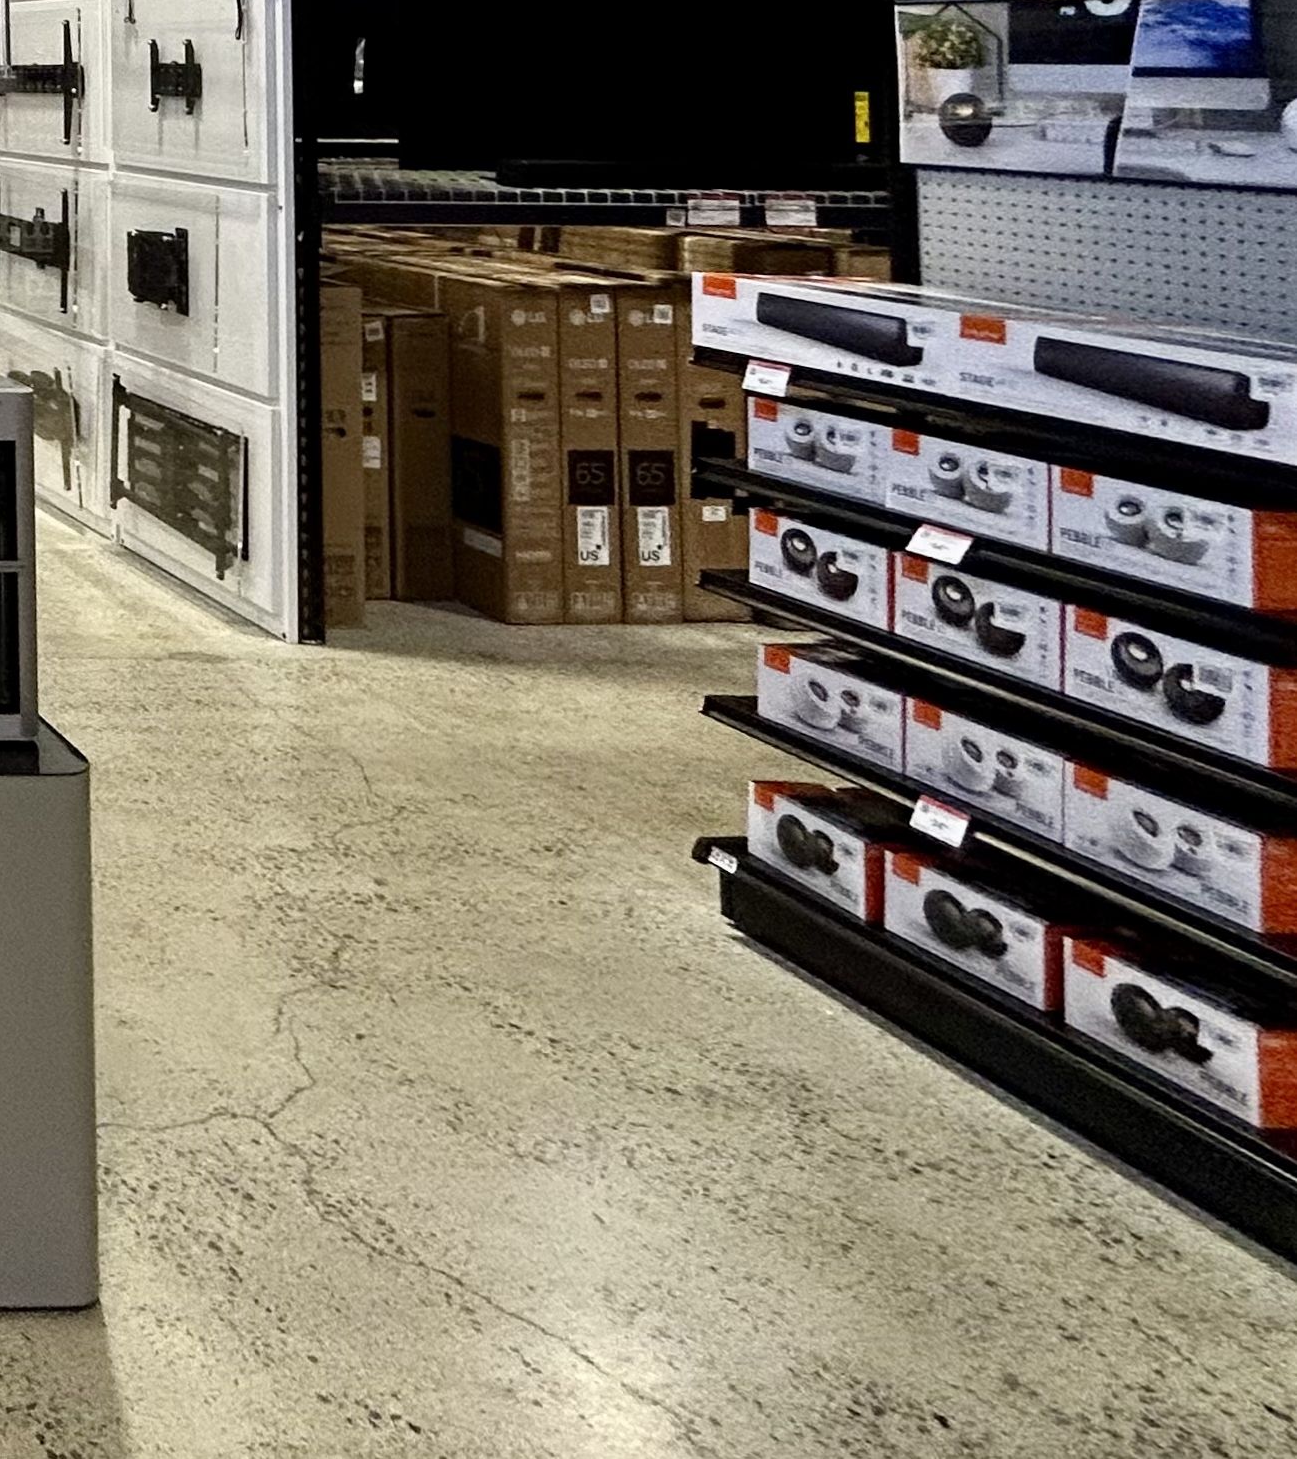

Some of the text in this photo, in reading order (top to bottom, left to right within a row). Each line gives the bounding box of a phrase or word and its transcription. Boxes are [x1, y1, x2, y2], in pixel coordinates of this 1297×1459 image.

[575, 462, 605, 486] 65
[636, 462, 667, 486] 65
[891, 483, 926, 502] PEBBLE
[1059, 526, 1103, 549] PEBBLE
[580, 550, 599, 562] US
[641, 550, 661, 562] US
